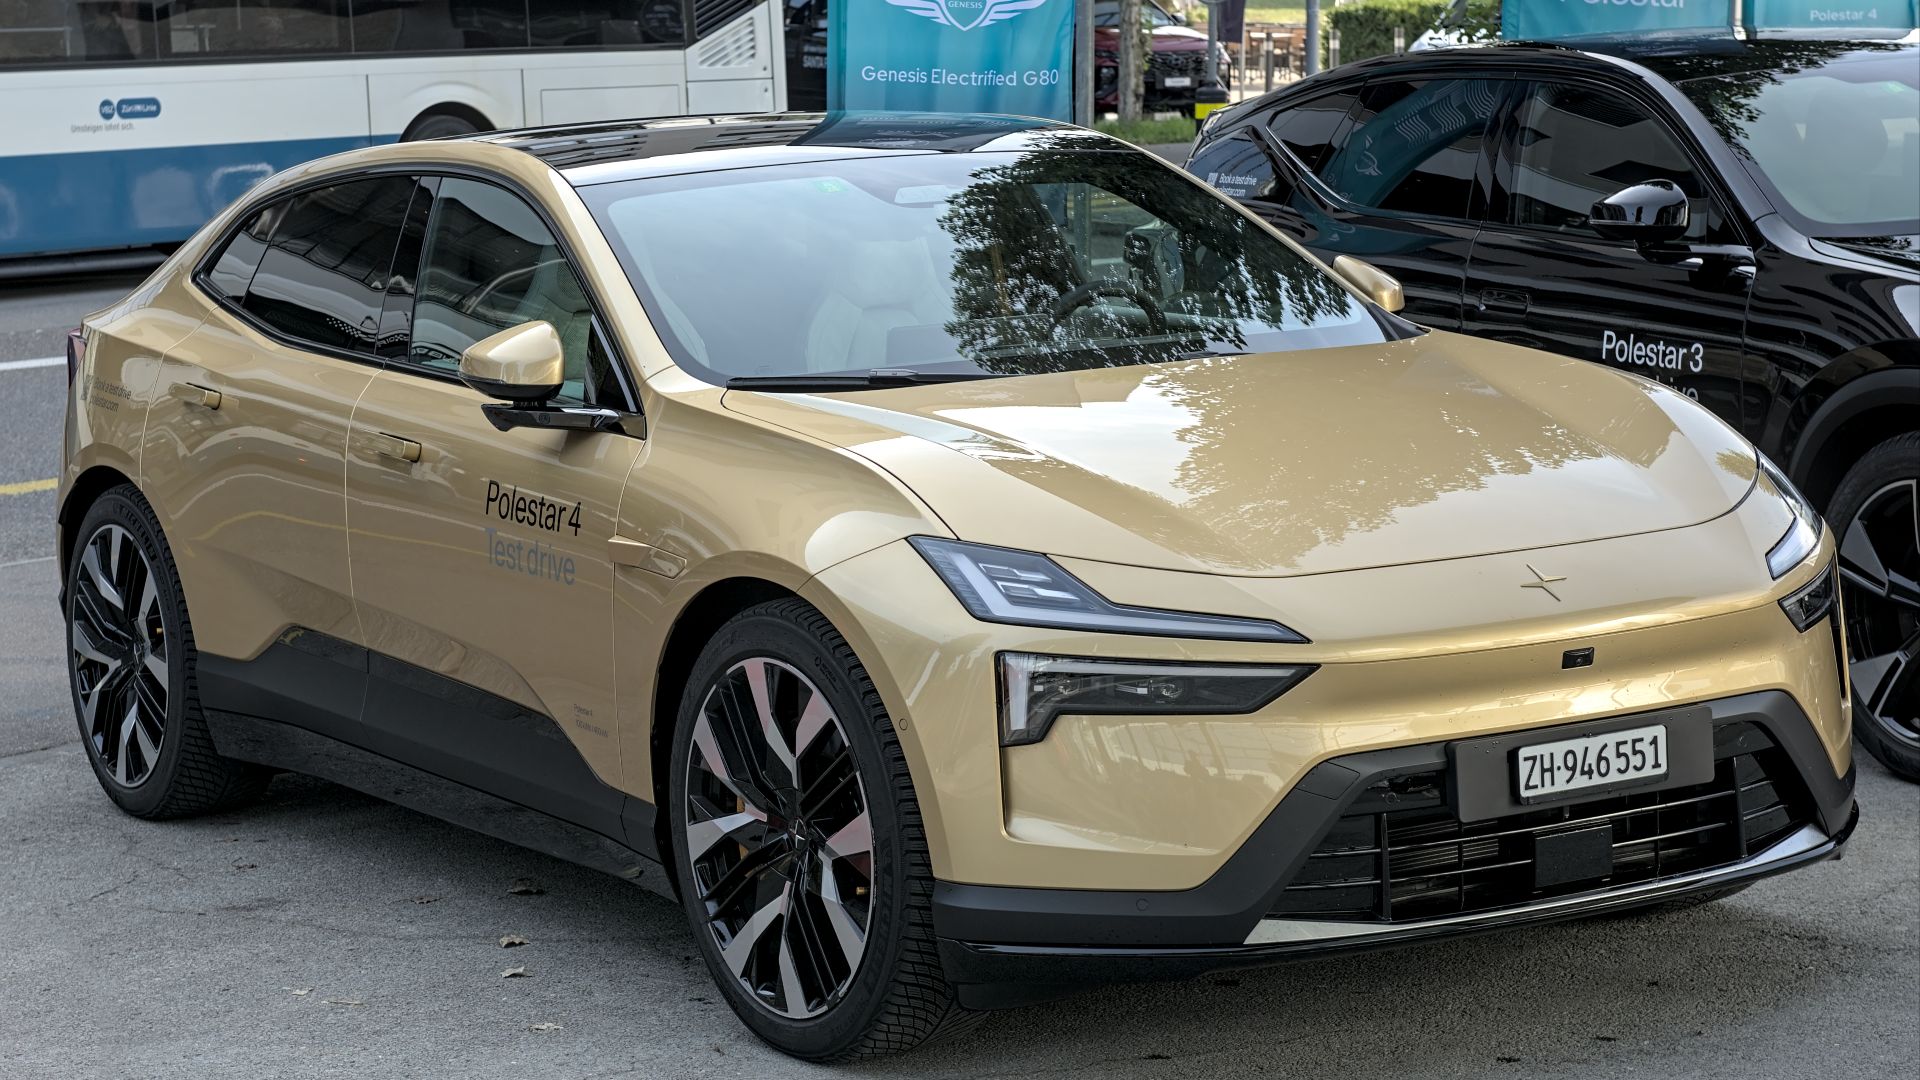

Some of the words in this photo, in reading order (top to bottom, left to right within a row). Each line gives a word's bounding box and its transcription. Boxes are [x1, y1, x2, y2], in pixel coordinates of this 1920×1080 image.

[948, 0, 983, 9] GENESIS
[1809, 9, 1864, 22] Polestar
[1867, 8, 1878, 20] 4
[861, 65, 928, 83] Genesis
[931, 68, 1017, 86] Electrified
[1023, 69, 1059, 86] G80
[1219, 173, 1232, 184] Book
[1235, 175, 1245, 185] test
[1244, 174, 1257, 186] drive
[1602, 329, 1688, 370] Polestar
[1689, 342, 1704, 373] 3
[486, 480, 566, 532] Polestar
[568, 501, 581, 536] 4
[484, 526, 524, 573] Test
[527, 540, 576, 586] drive
